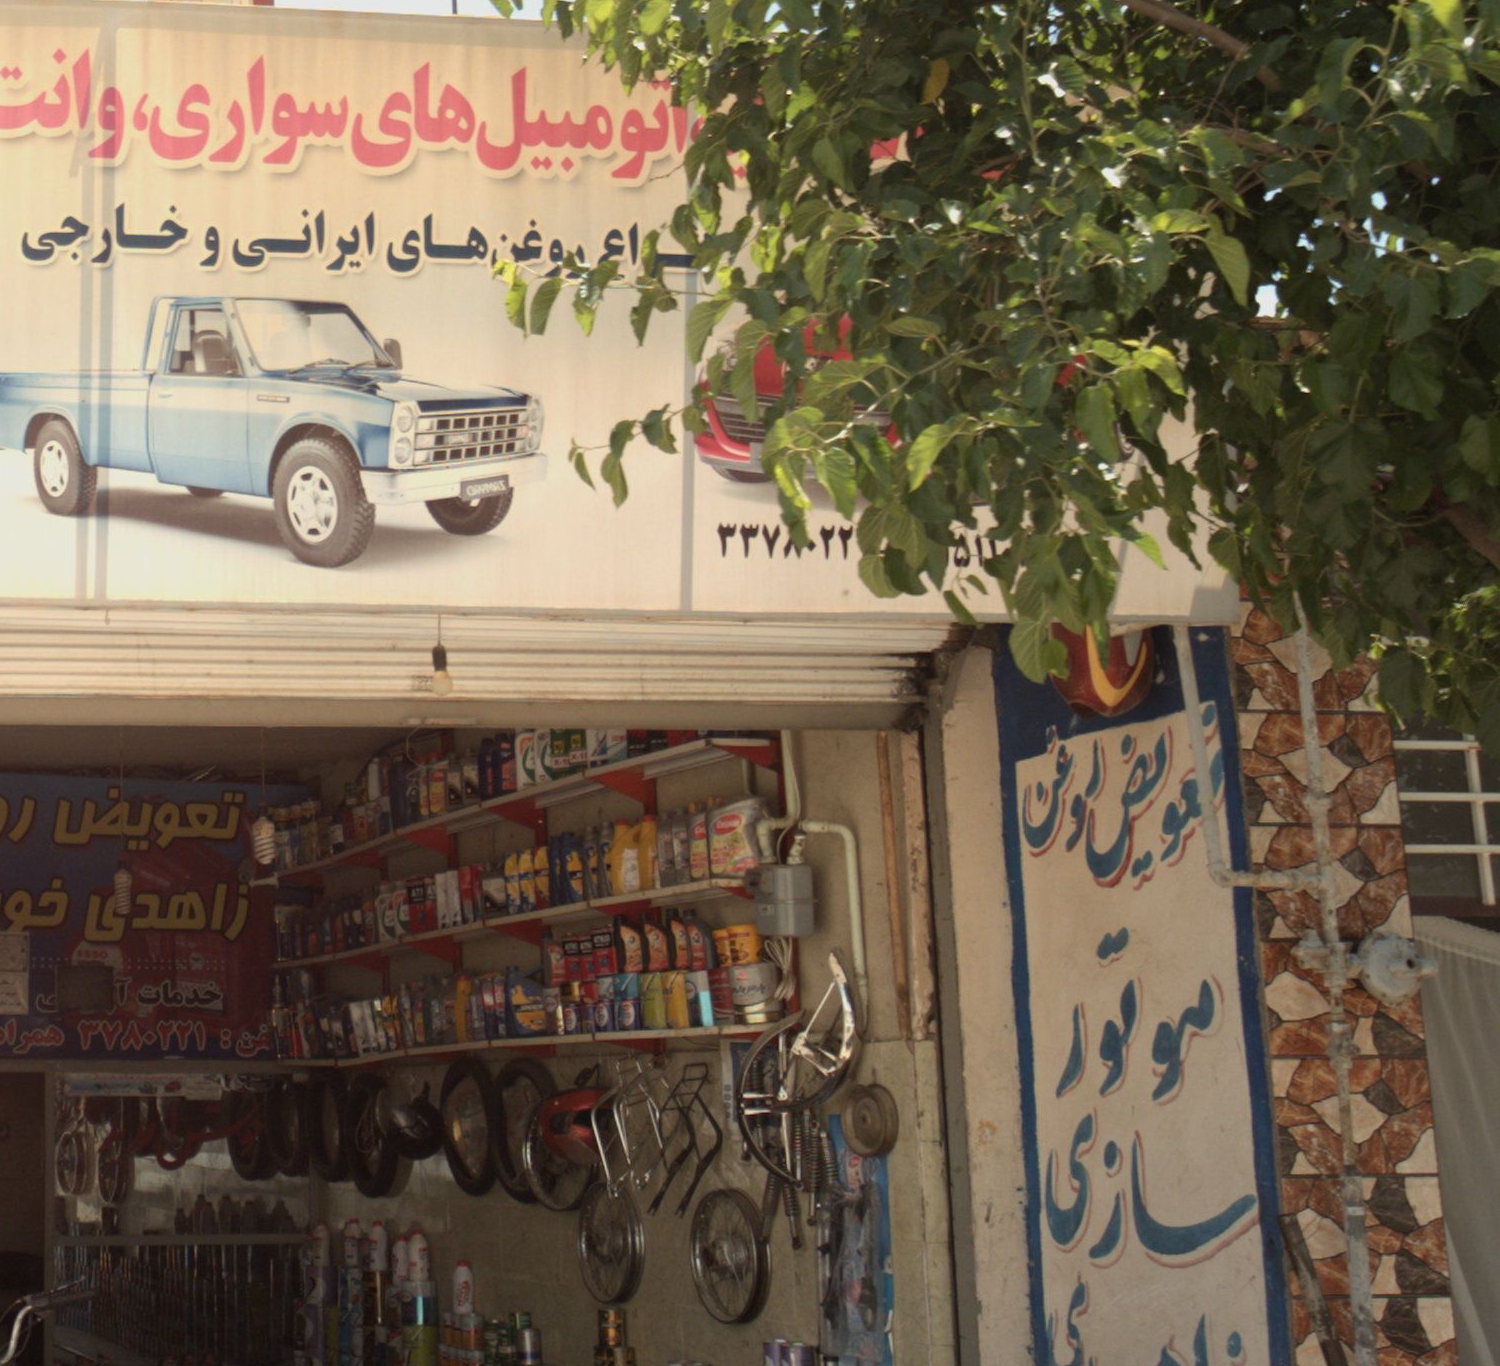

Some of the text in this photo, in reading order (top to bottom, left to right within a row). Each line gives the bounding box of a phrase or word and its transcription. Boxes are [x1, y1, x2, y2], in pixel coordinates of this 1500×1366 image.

[23, 203, 189, 266] خارجی
[201, 223, 221, 268] و
[232, 208, 375, 272] ایرانی
[53, 785, 246, 851] تعویض
[1023, 703, 1227, 878] تعویض روغن
[85, 881, 250, 941] زاهدی
[137, 981, 223, 1008] خدمات
[1056, 927, 1216, 1101] موتور
[1045, 1113, 1258, 1259] سازی
